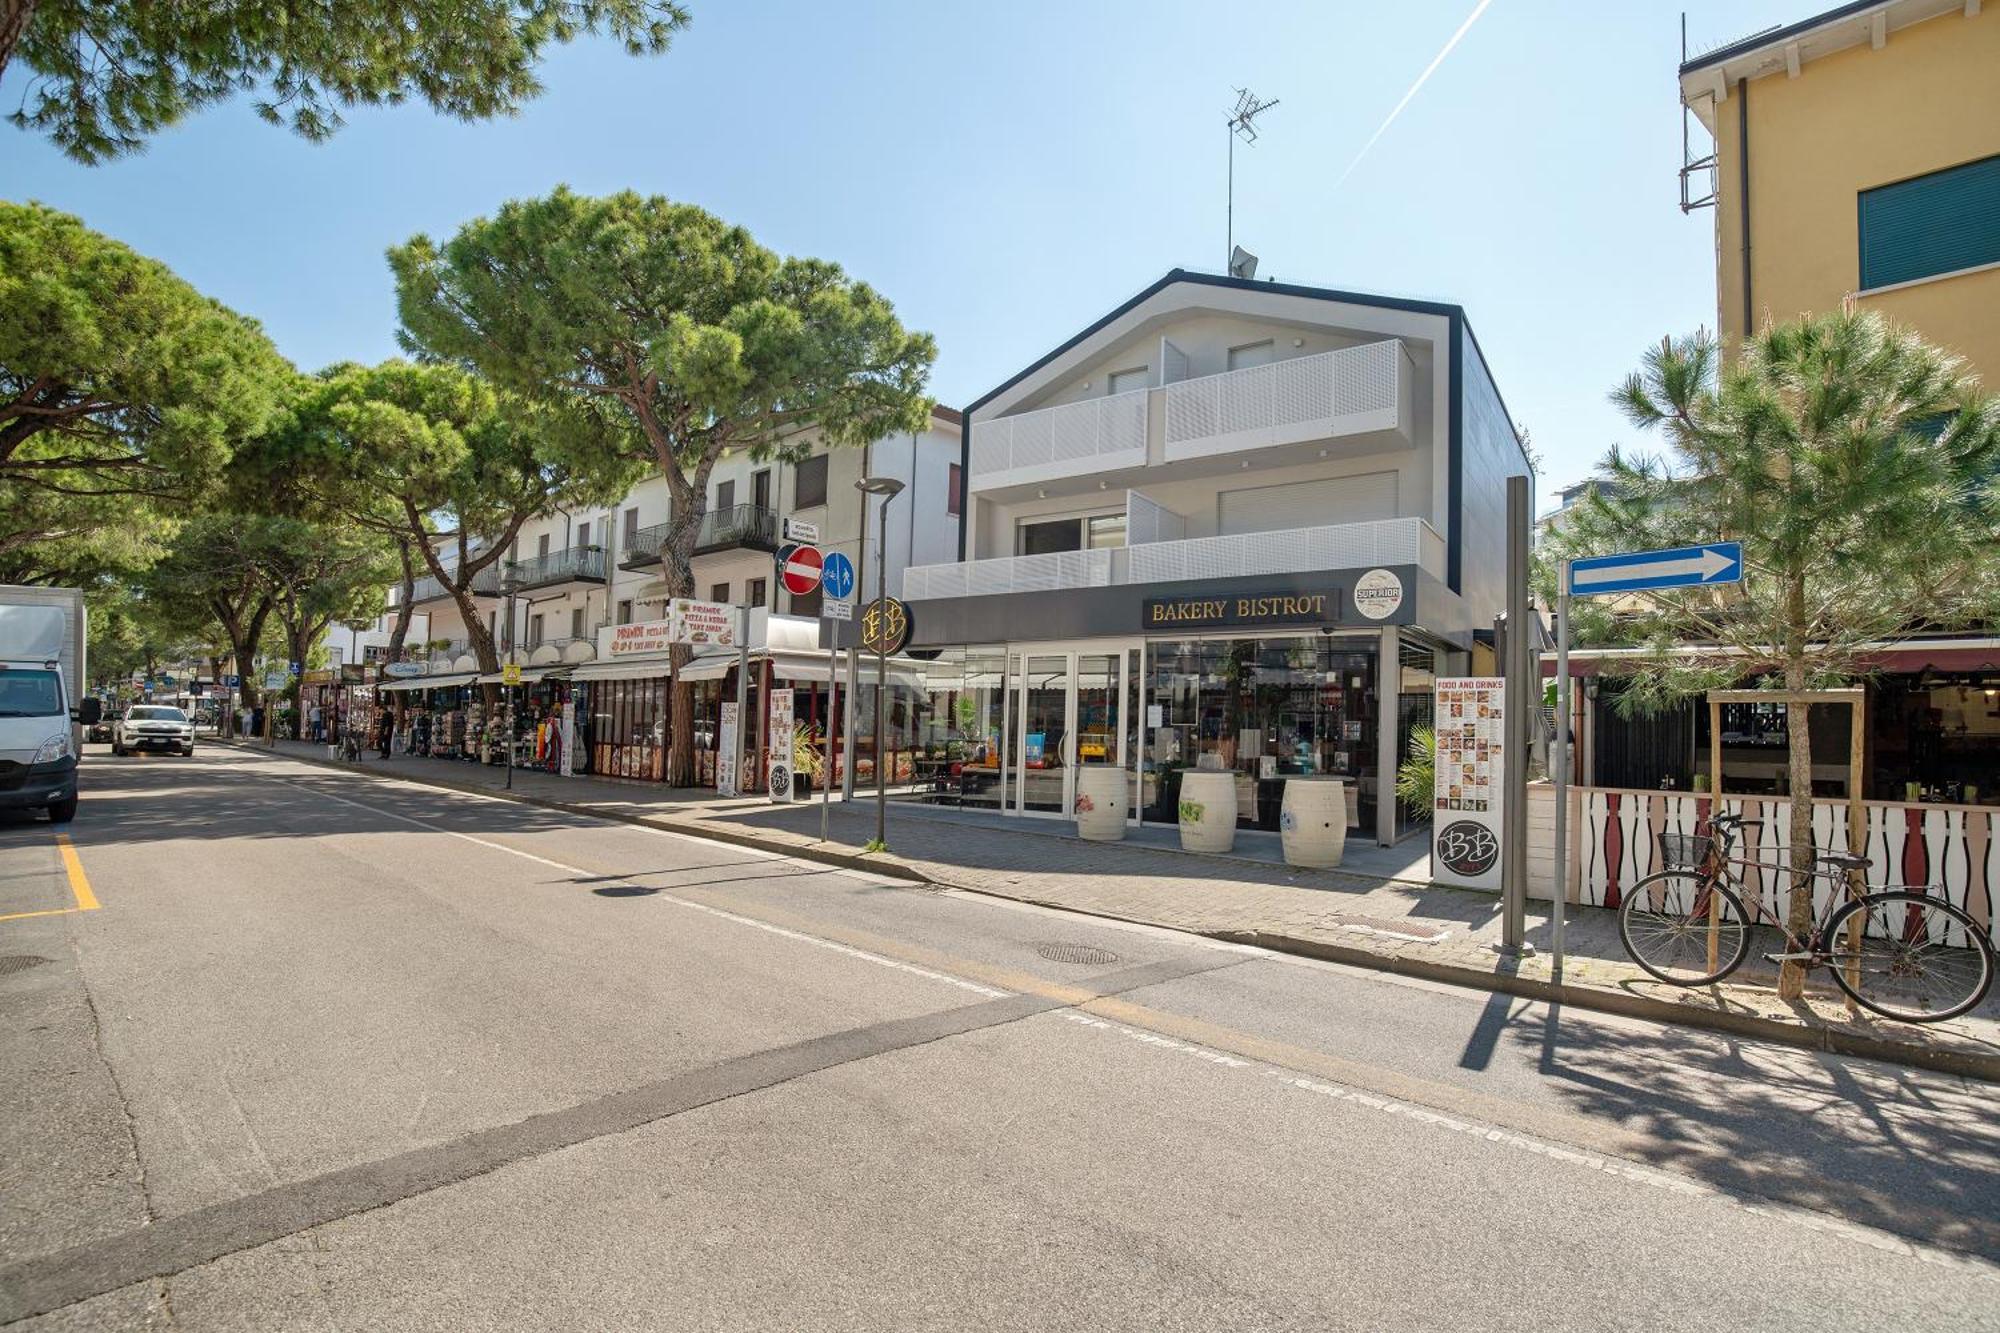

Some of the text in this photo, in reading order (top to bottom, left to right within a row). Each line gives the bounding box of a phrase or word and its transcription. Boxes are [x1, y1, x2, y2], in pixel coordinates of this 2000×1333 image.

[1357, 588, 1399, 599] SUPERIOR
[1152, 595, 1326, 621] BAKERY BISTROT
[1438, 680, 1504, 689] FOOD AND DRINKS
[1438, 829, 1497, 863] BB
